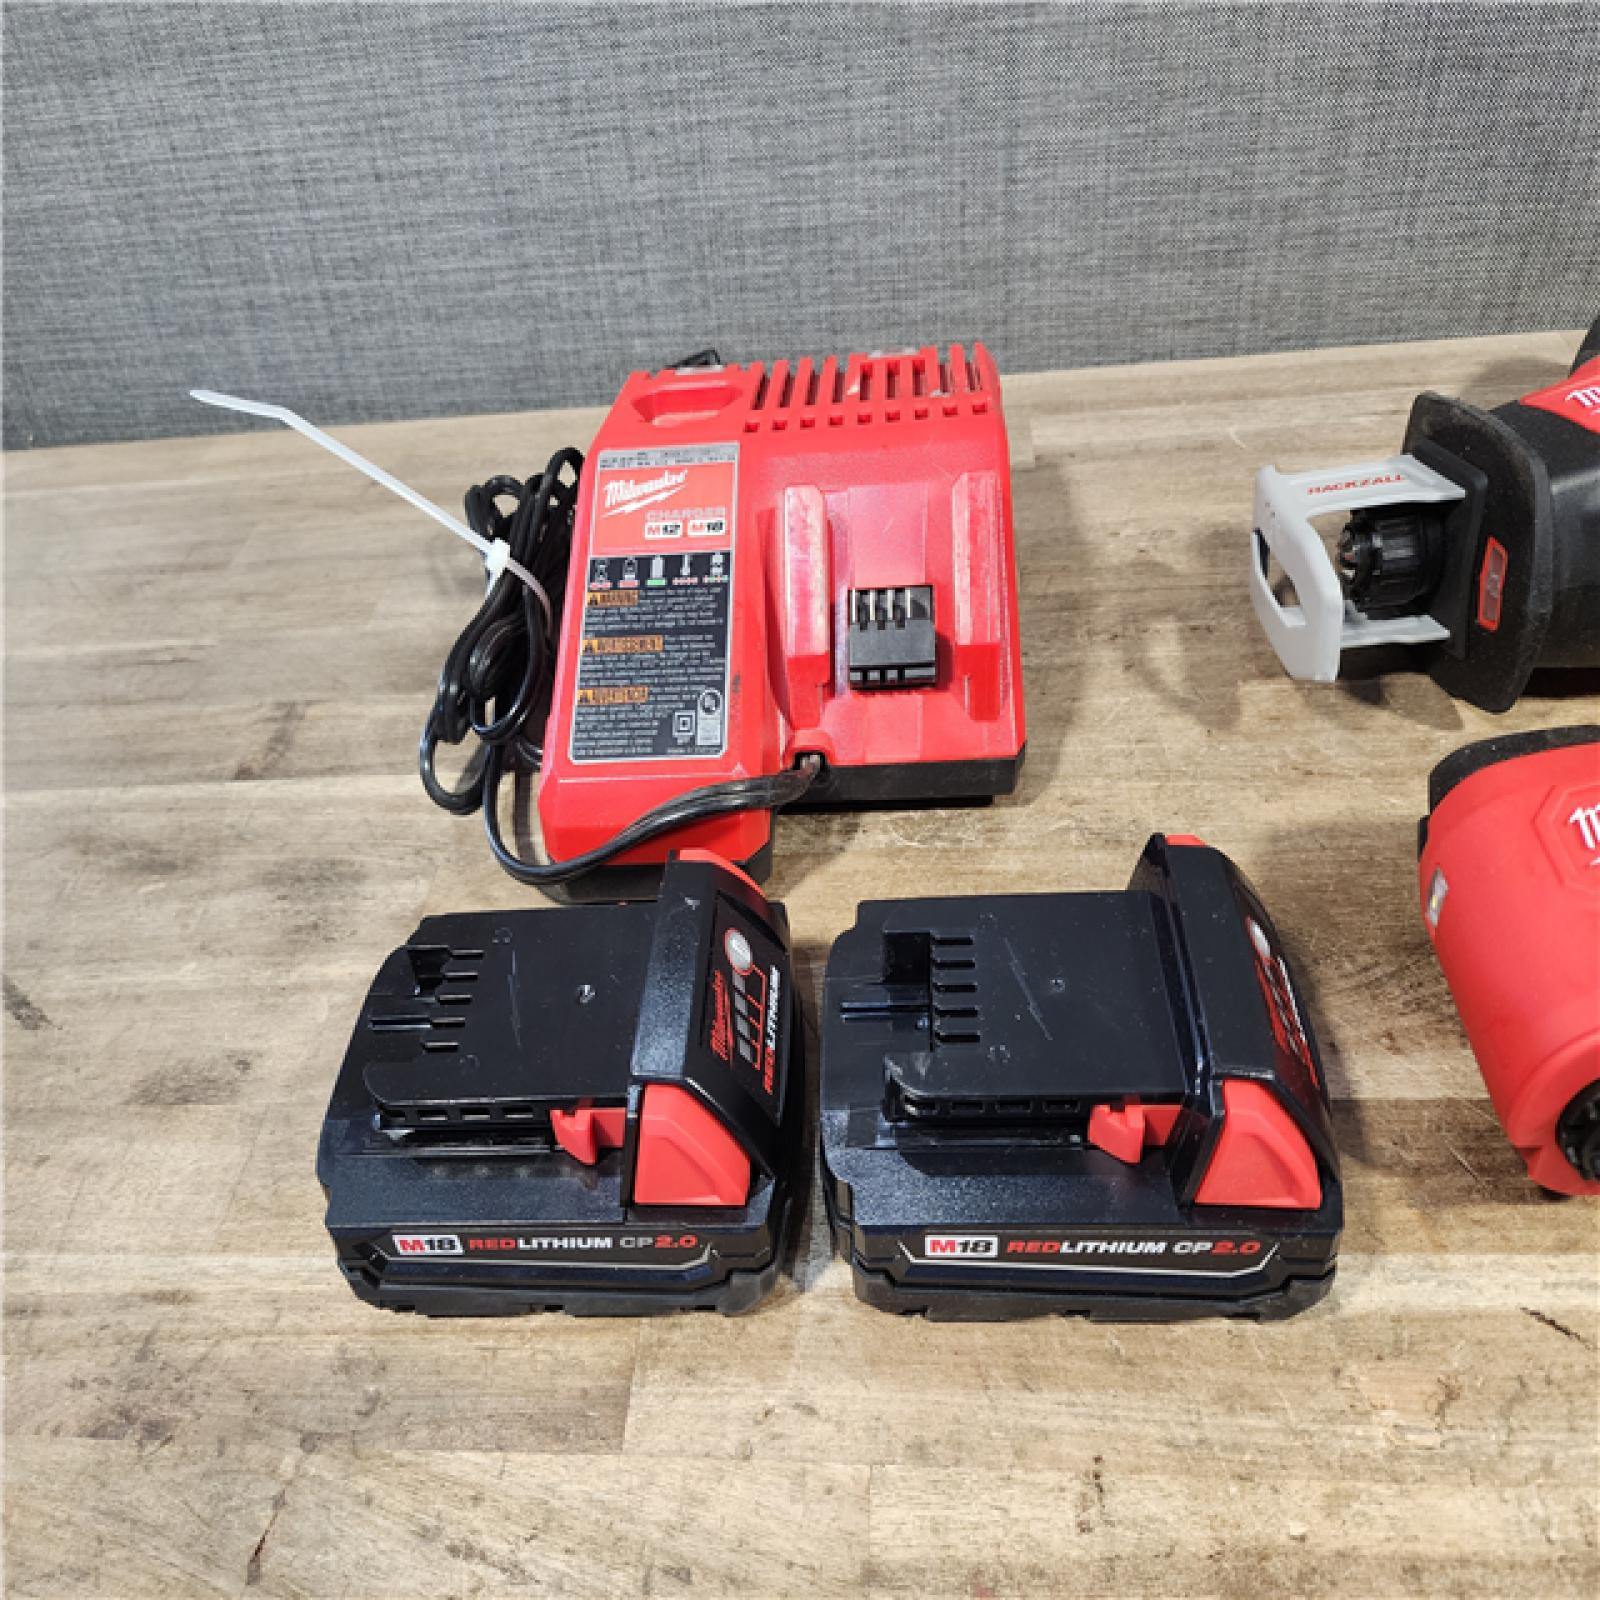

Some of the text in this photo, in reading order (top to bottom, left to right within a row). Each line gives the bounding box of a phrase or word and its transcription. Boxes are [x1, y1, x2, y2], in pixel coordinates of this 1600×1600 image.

[1307, 473, 1405, 496] HACKZALL
[690, 520, 724, 533] M18
[398, 1237, 459, 1252] M18
[469, 1236, 613, 1250] REDLITHIUM
[929, 1238, 993, 1254] M18
[1006, 1239, 1168, 1254] REDLITHIUM
